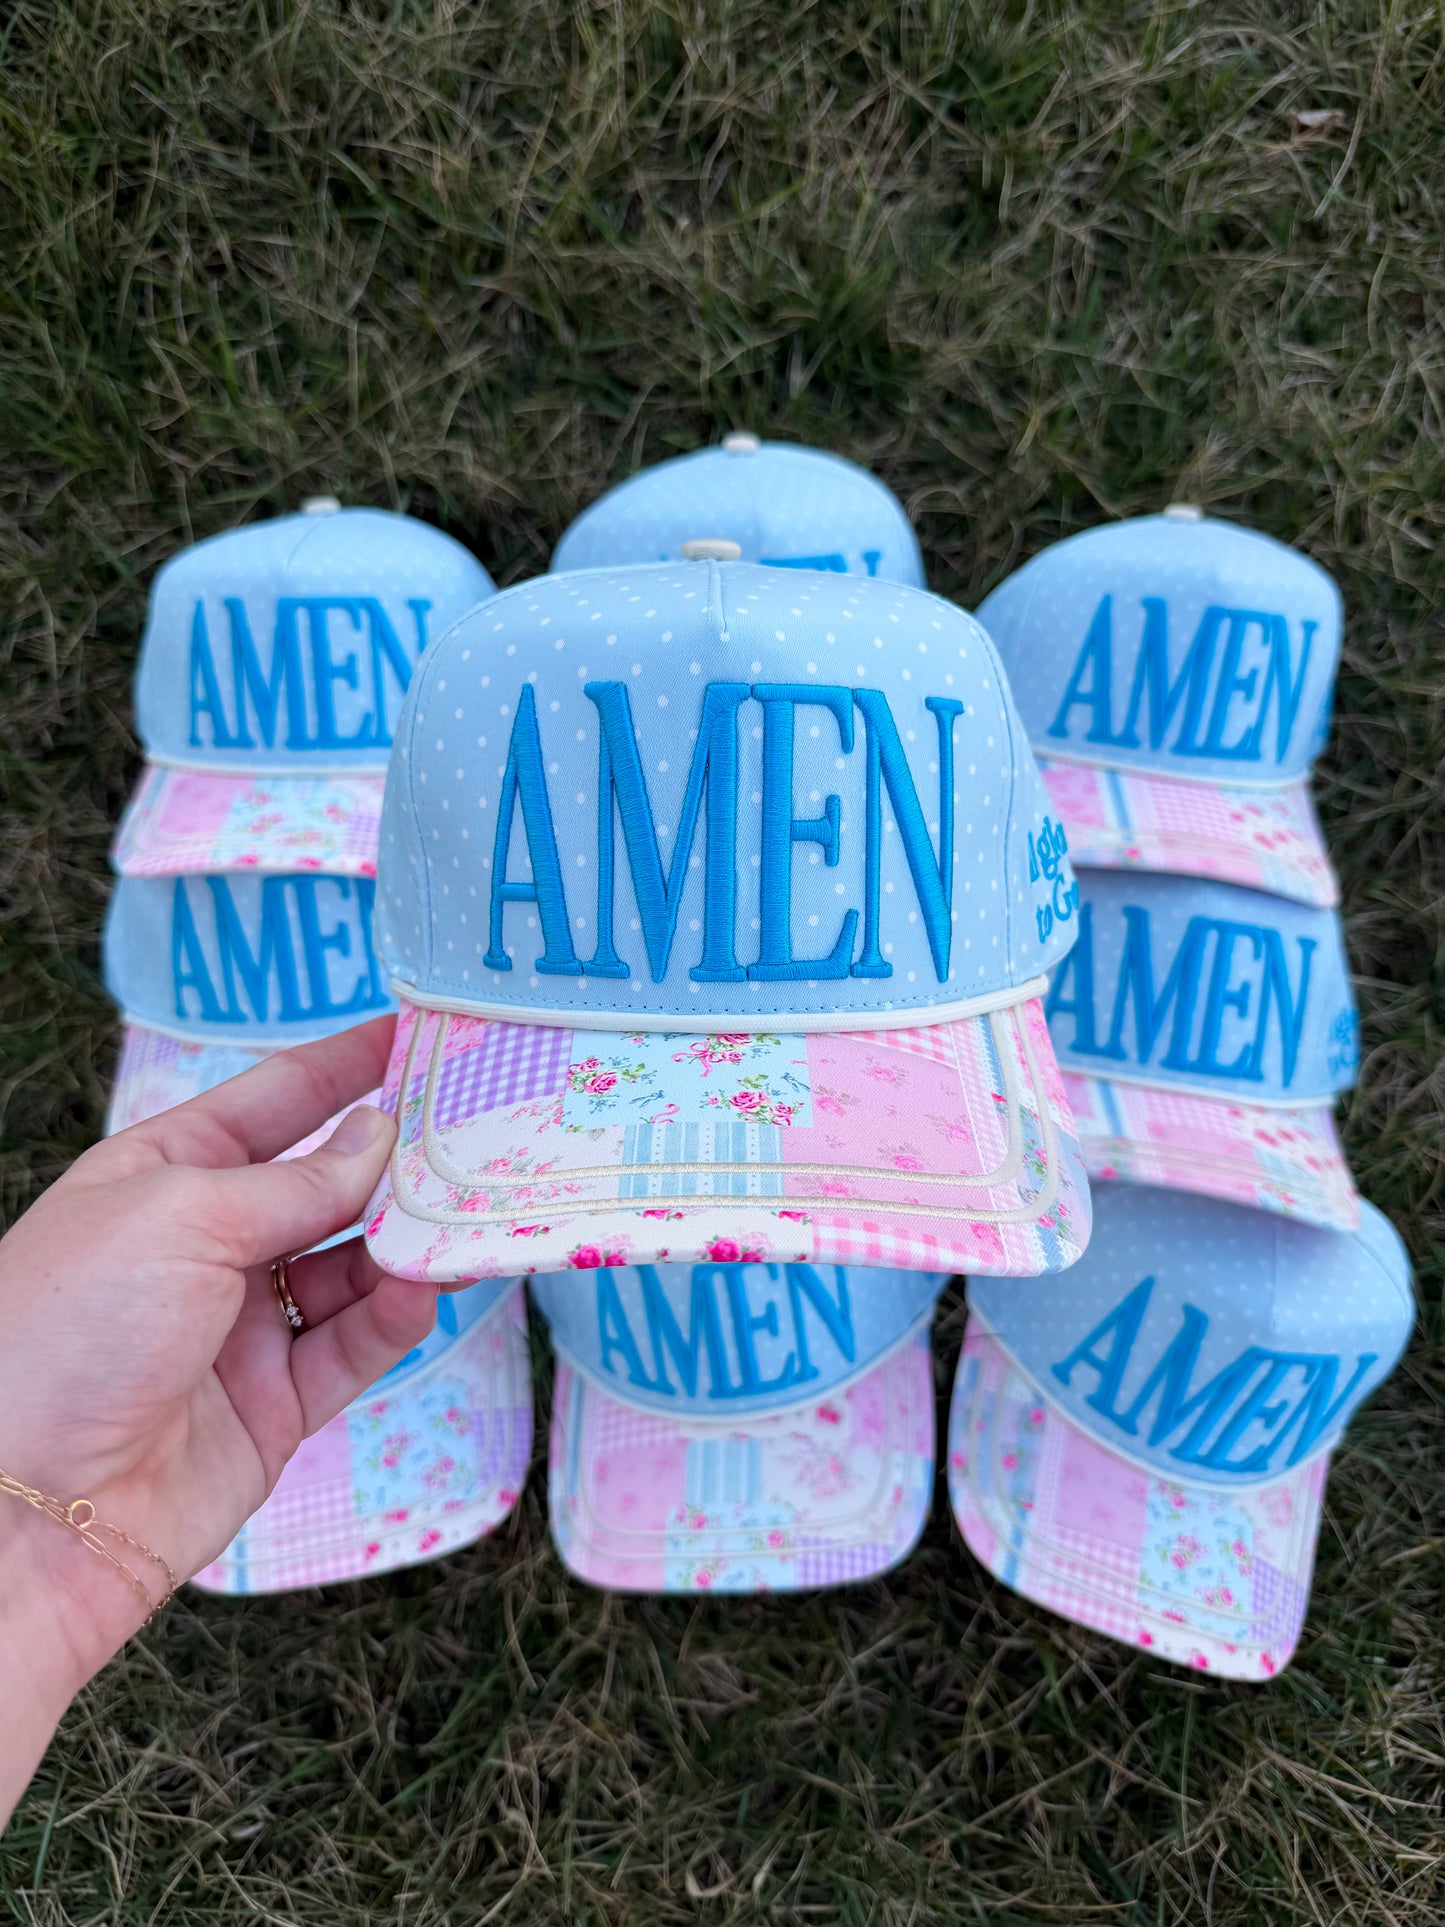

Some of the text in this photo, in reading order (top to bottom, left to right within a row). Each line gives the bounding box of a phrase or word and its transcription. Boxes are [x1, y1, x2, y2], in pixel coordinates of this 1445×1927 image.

[188, 596, 432, 750] AMEN
[1046, 593, 1319, 765] AMEN
[483, 680, 965, 984] AMEN
[172, 875, 391, 1025] AME
[1046, 900, 1318, 1089] AMEN
[596, 1262, 856, 1399] AMEN
[1051, 1275, 1379, 1473] AMEN
